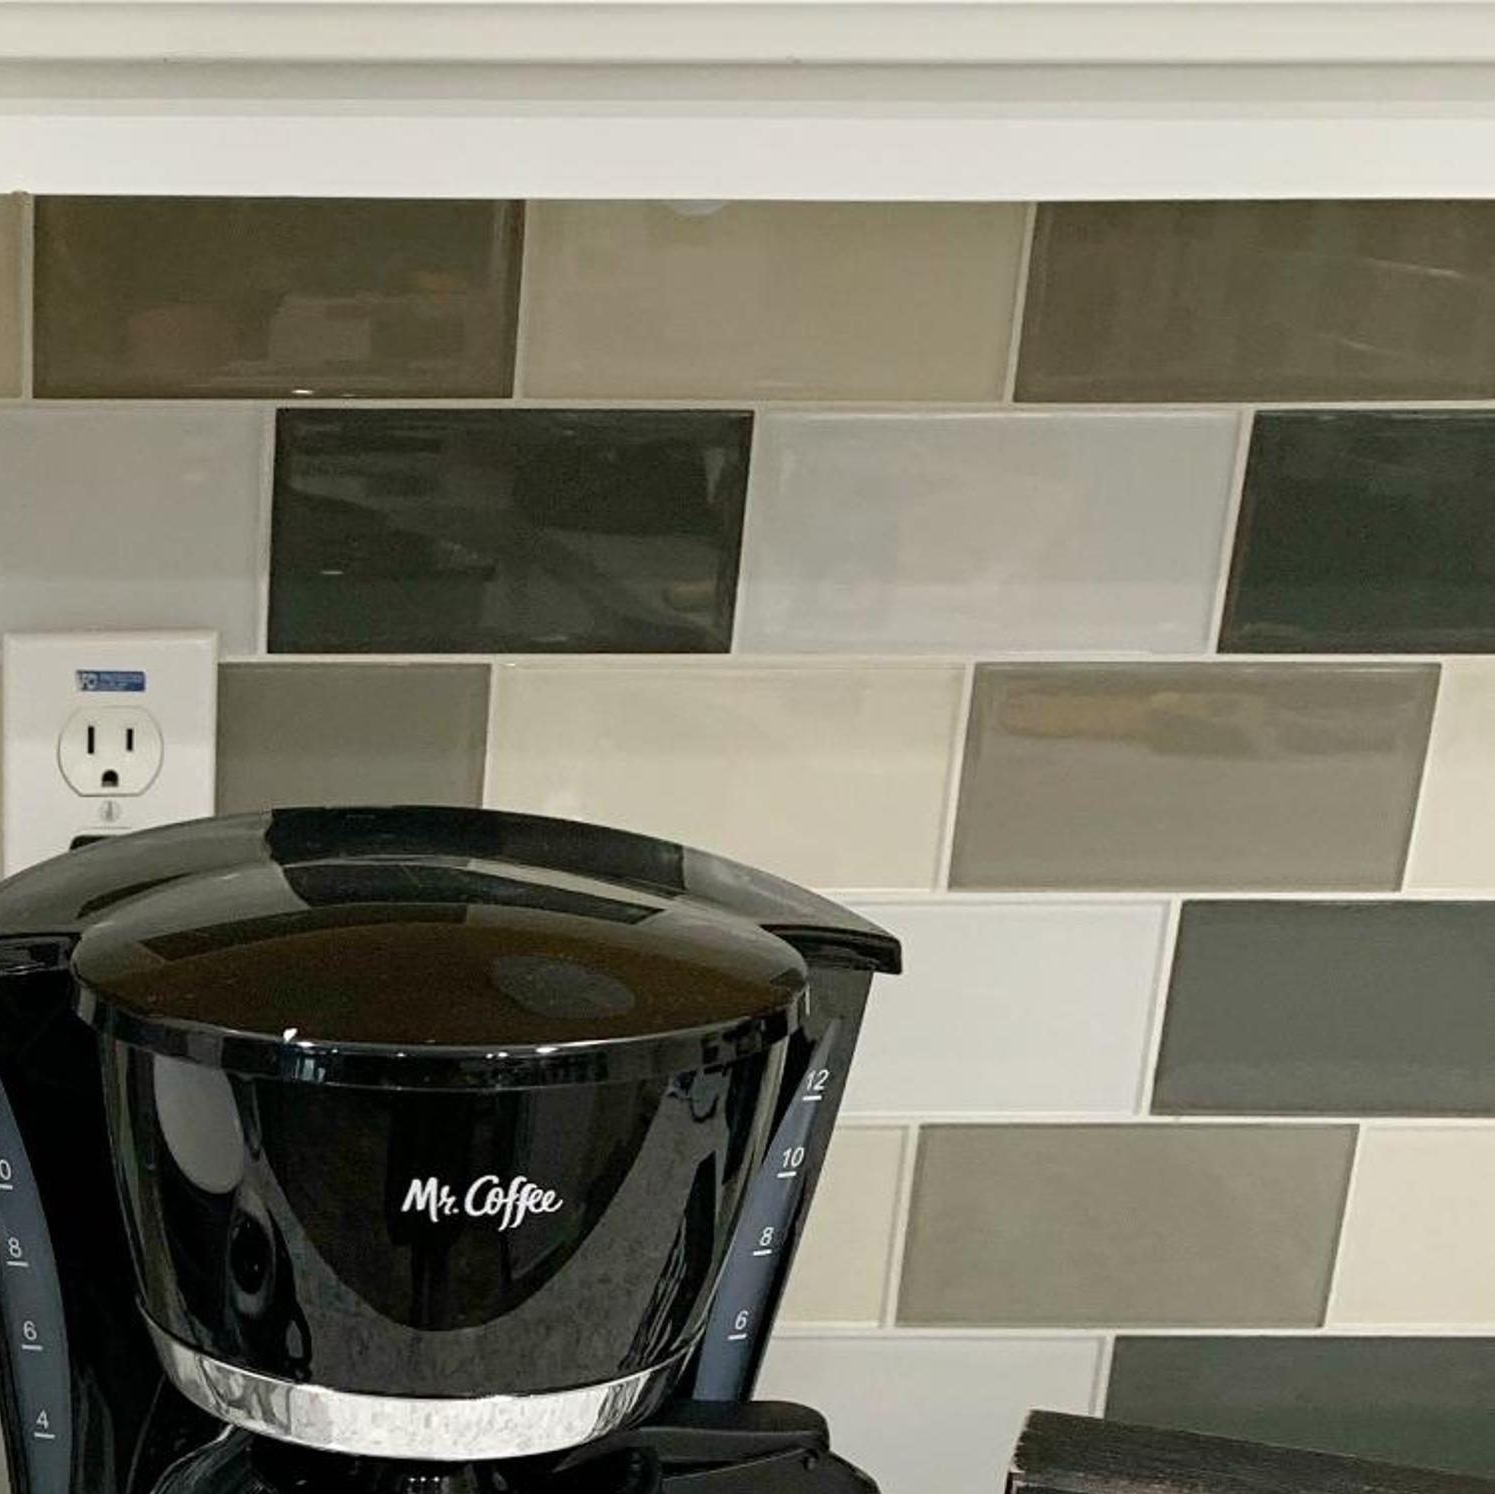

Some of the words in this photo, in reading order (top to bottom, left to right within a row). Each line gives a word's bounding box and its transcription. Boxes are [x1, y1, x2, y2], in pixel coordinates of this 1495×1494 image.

[806, 1069, 830, 1091] 12
[782, 1147, 805, 1168] 10
[401, 1176, 460, 1223] Mr.
[463, 1174, 564, 1232] Coffee
[759, 1226, 774, 1246] 8
[7, 1236, 22, 1259] 8
[22, 1320, 38, 1341] 6
[735, 1310, 749, 1330] 6
[35, 1409, 50, 1430] 4
